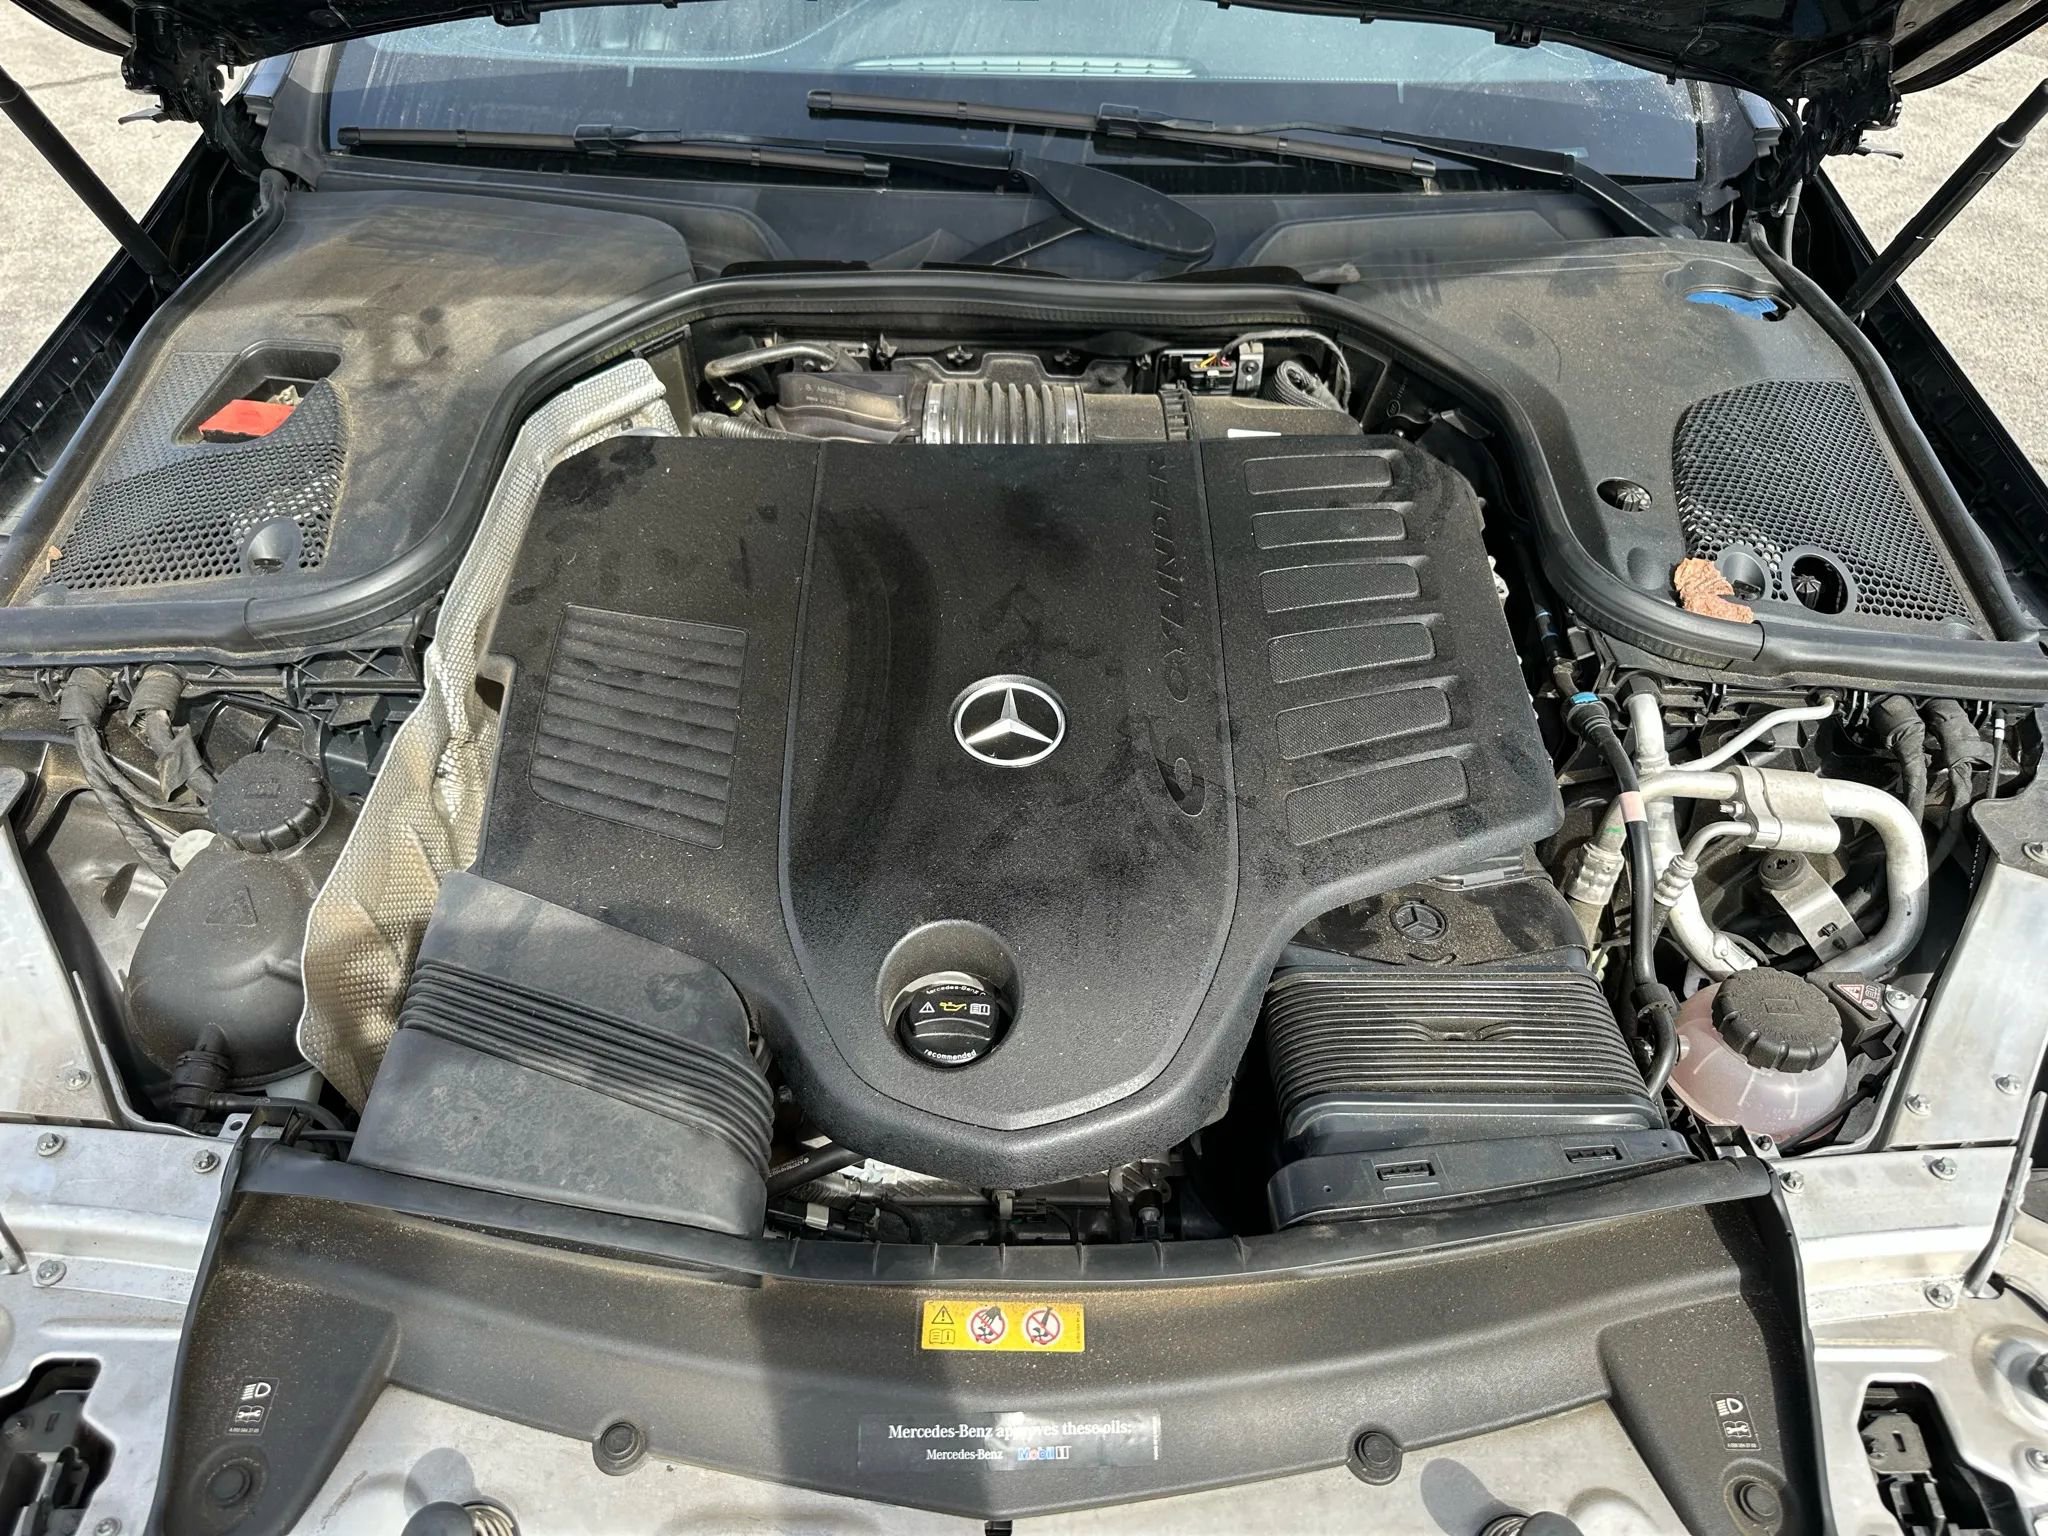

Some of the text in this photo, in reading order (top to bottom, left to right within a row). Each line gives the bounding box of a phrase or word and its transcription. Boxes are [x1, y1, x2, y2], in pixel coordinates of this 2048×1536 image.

[923, 1048, 977, 1061] recommended
[888, 1423, 993, 1439] Mercedes-Benz
[995, 1424, 1059, 1441] apves
[1062, 1421, 1099, 1435] these
[926, 1448, 1003, 1460] Mercedes-Benz
